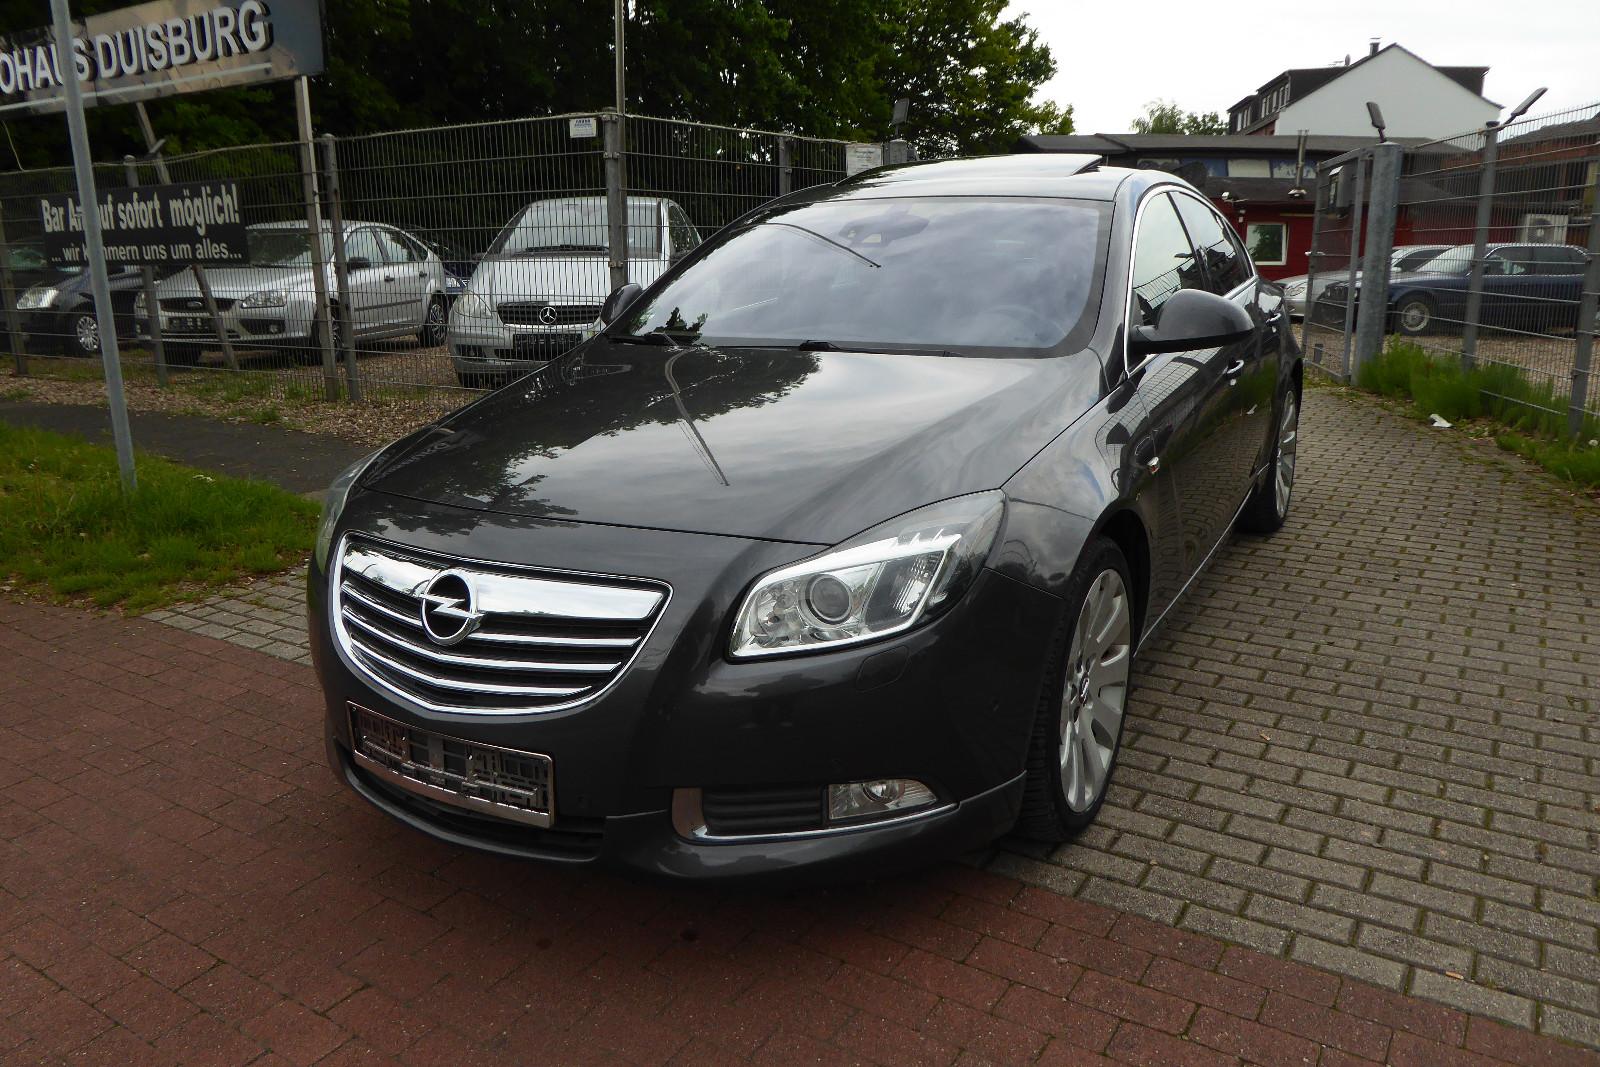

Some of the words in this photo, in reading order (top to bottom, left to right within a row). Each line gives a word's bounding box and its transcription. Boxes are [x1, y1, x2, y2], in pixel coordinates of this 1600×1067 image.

[95, 0, 270, 78] DUISBURG
[41, 199, 65, 232] Bar
[117, 191, 164, 230] sofort
[169, 183, 240, 236] möglich!
[142, 244, 168, 260] uns
[171, 243, 193, 260] um
